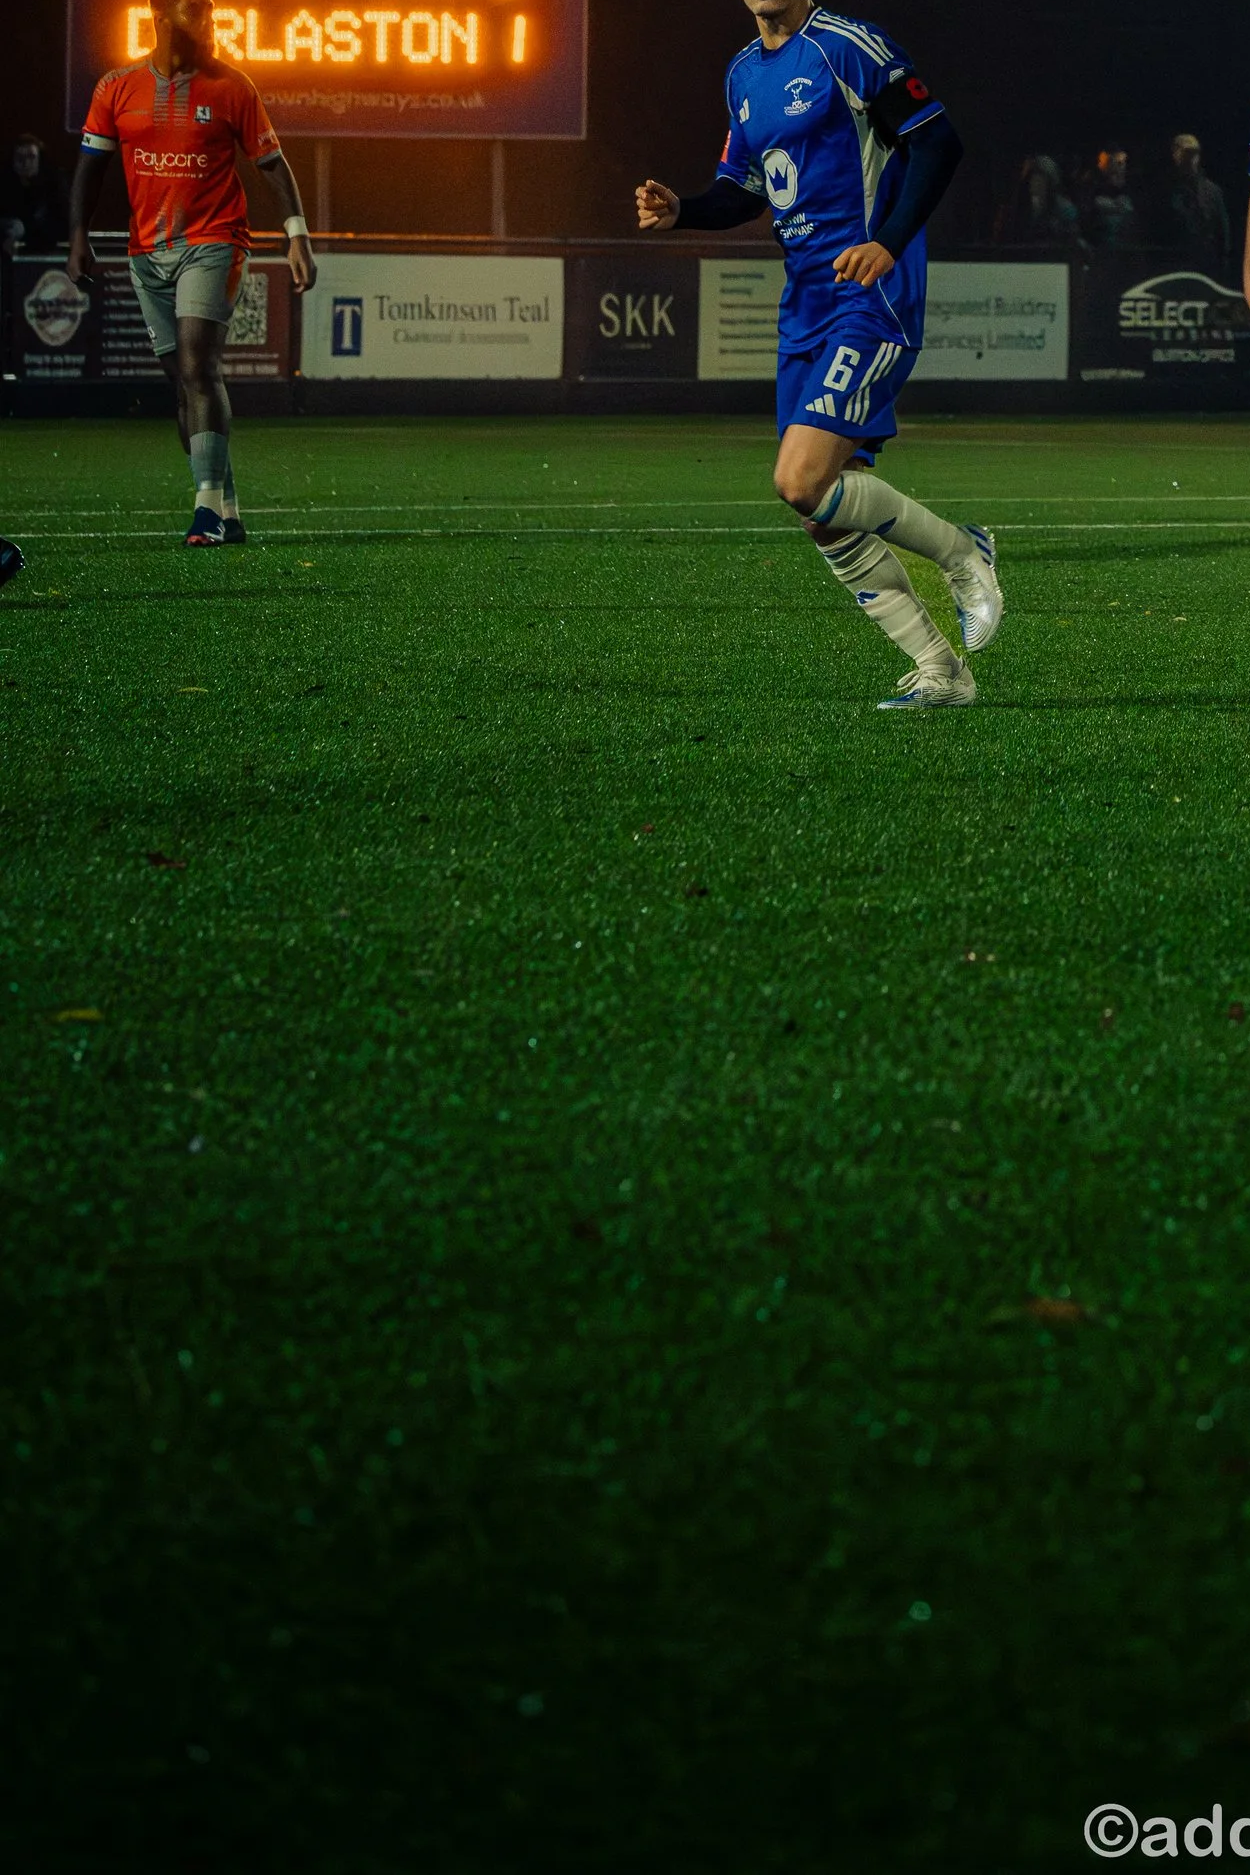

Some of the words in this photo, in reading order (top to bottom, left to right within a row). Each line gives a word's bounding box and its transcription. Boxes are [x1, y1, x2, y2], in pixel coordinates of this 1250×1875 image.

[126, 5, 479, 65] DRLASTON
[509, 13, 528, 64] 1
[261, 85, 484, 114] ownhighways.co.uk
[373, 294, 498, 322] Tomkinson
[503, 296, 551, 323] Teal
[598, 292, 676, 339] SKK
[1119, 300, 1210, 328] SELECT
[823, 345, 861, 392] 6
